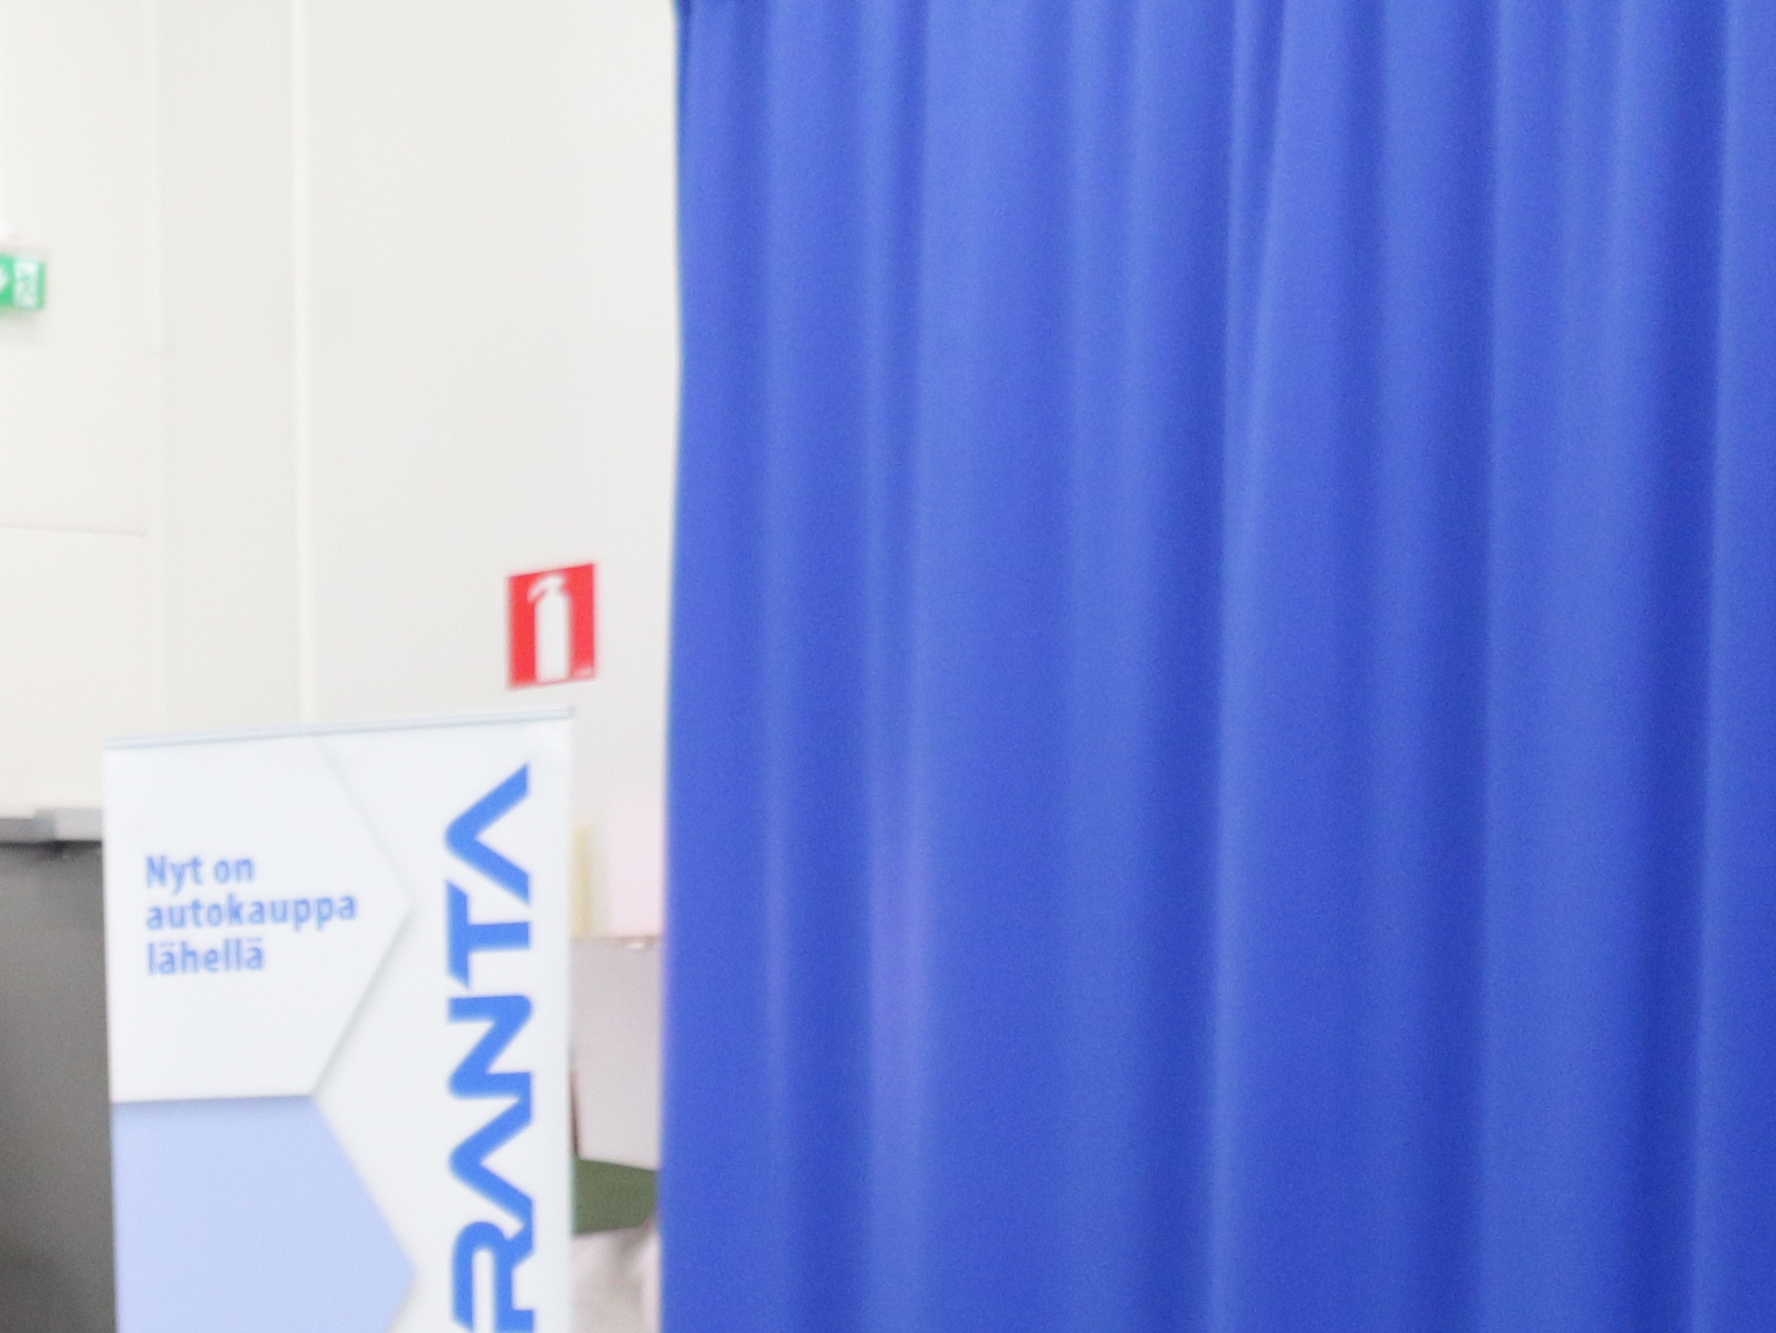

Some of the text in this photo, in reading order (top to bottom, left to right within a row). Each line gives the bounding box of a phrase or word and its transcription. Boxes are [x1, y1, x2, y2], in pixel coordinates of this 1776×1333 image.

[146, 856, 255, 895] Nyt on
[147, 893, 357, 932] autokauppa
[148, 937, 264, 974] lähellä
